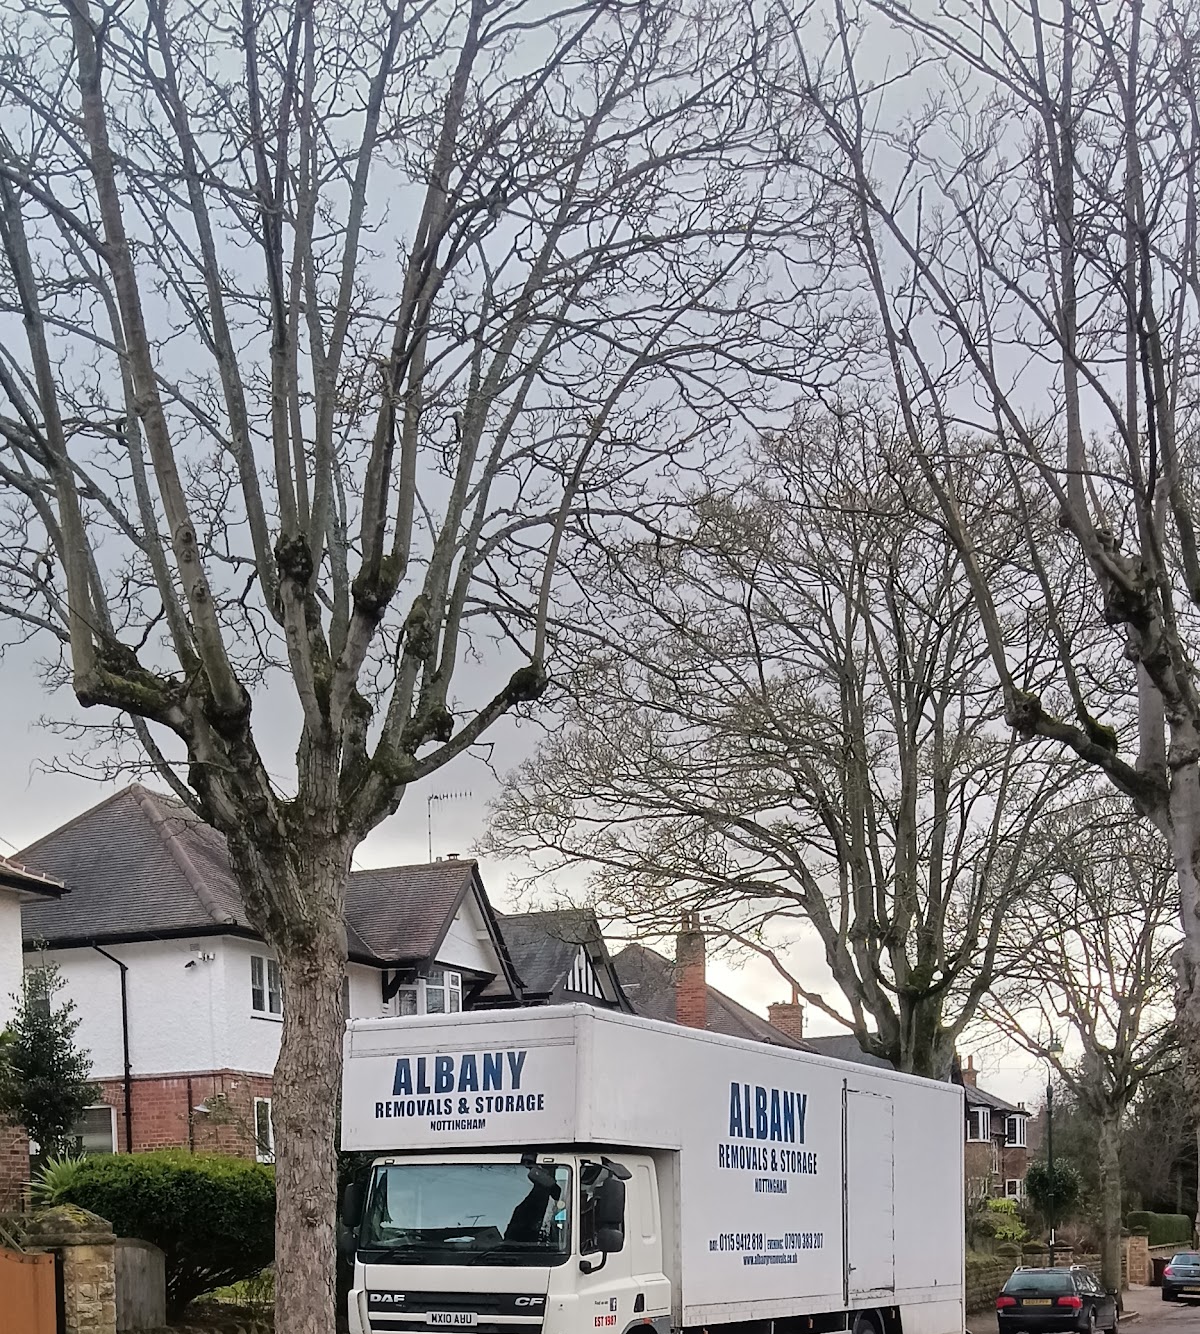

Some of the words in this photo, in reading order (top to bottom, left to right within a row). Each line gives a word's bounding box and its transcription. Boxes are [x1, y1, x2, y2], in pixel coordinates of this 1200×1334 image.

[392, 1051, 527, 1096] ALBANY
[375, 1098, 453, 1118] REMOVALS
[458, 1097, 470, 1114] &
[475, 1094, 545, 1114] STORAGE
[729, 1082, 807, 1144] ALBANY
[430, 1118, 486, 1131] NOTTINGHAM
[718, 1144, 768, 1171] REMOVALS
[771, 1148, 778, 1171] &
[780, 1149, 818, 1174] STORAGE
[754, 1178, 787, 1194] NOTTINGHAM
[719, 1233, 735, 1251] 0115
[736, 1233, 750, 1250] 9412
[752, 1233, 763, 1250] 818
[785, 1233, 801, 1249] 07970
[802, 1232, 812, 1249] 383
[813, 1232, 823, 1249] 207
[370, 1294, 405, 1302] DAF
[515, 1297, 545, 1306] CF
[431, 1313, 452, 1323] MX10
[594, 1316, 604, 1327] EST
